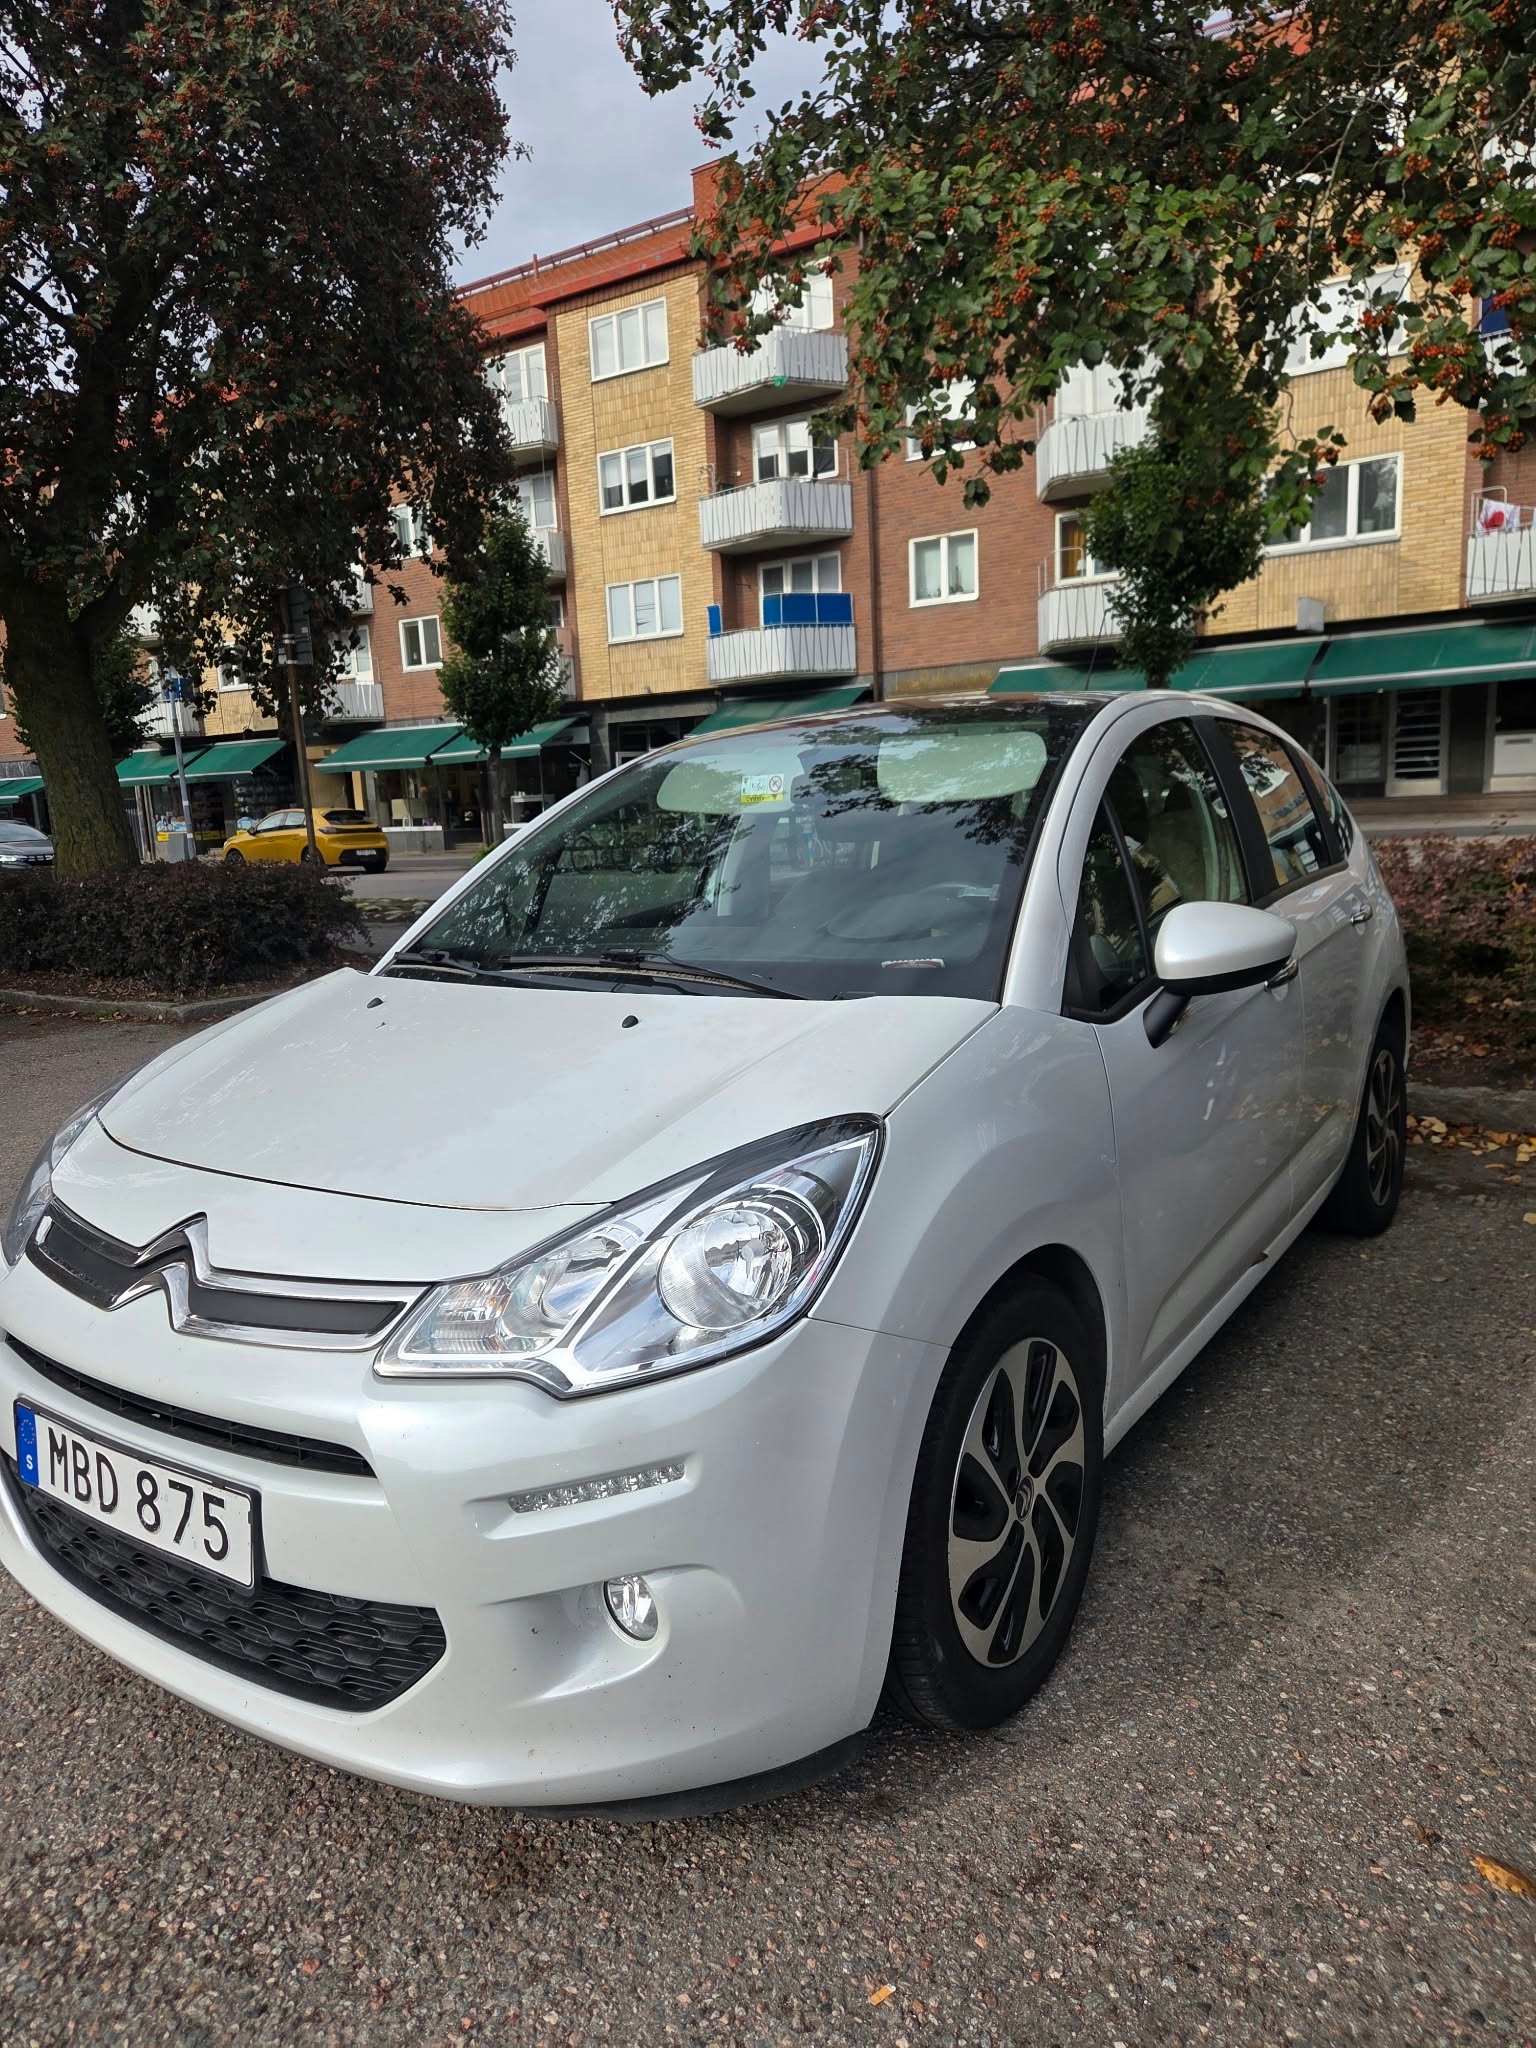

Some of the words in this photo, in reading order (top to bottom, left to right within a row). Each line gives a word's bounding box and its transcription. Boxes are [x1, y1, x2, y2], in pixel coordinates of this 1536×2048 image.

[26, 1454, 34, 1471] S
[48, 1427, 118, 1512] MBD
[136, 1470, 228, 1560] 875
